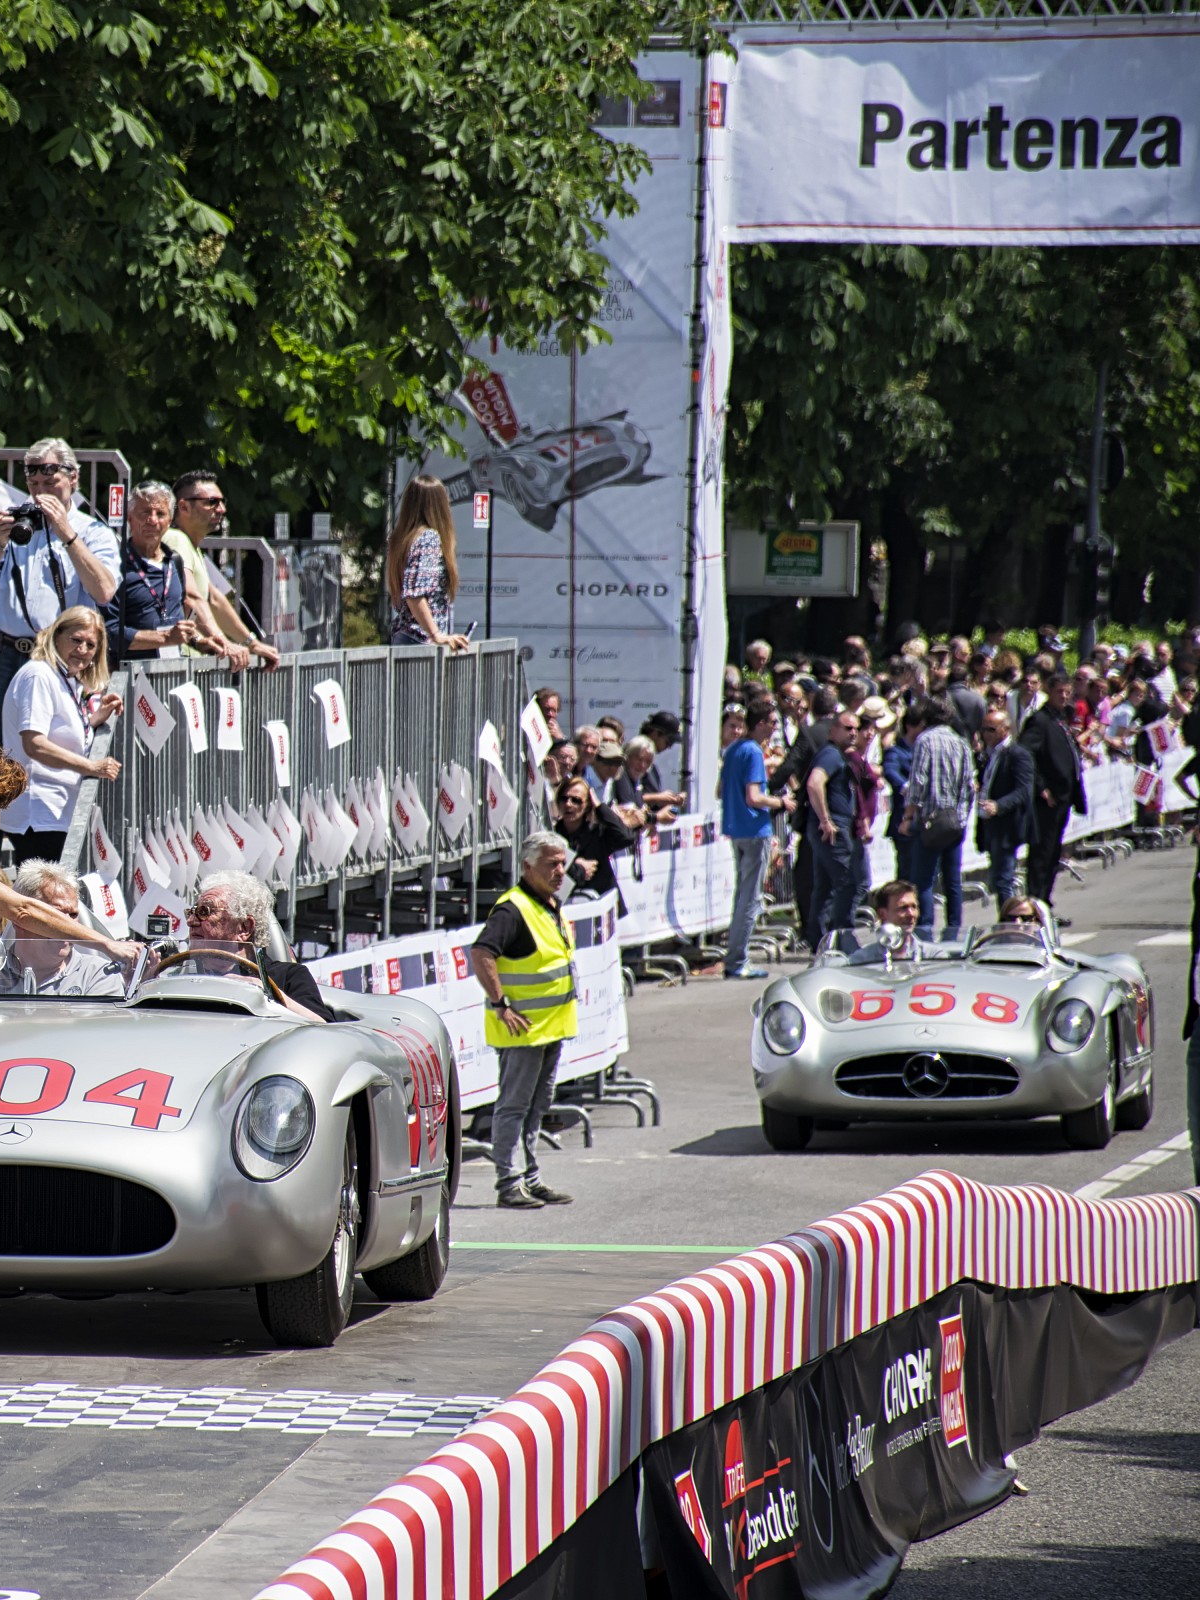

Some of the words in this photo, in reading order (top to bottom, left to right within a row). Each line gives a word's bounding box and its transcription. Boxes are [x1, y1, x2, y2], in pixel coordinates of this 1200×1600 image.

[858, 102, 1182, 172] Partenza
[556, 583, 668, 597] CHOPARD
[850, 983, 1020, 1024] 658
[944, 1331, 960, 1374] 1000
